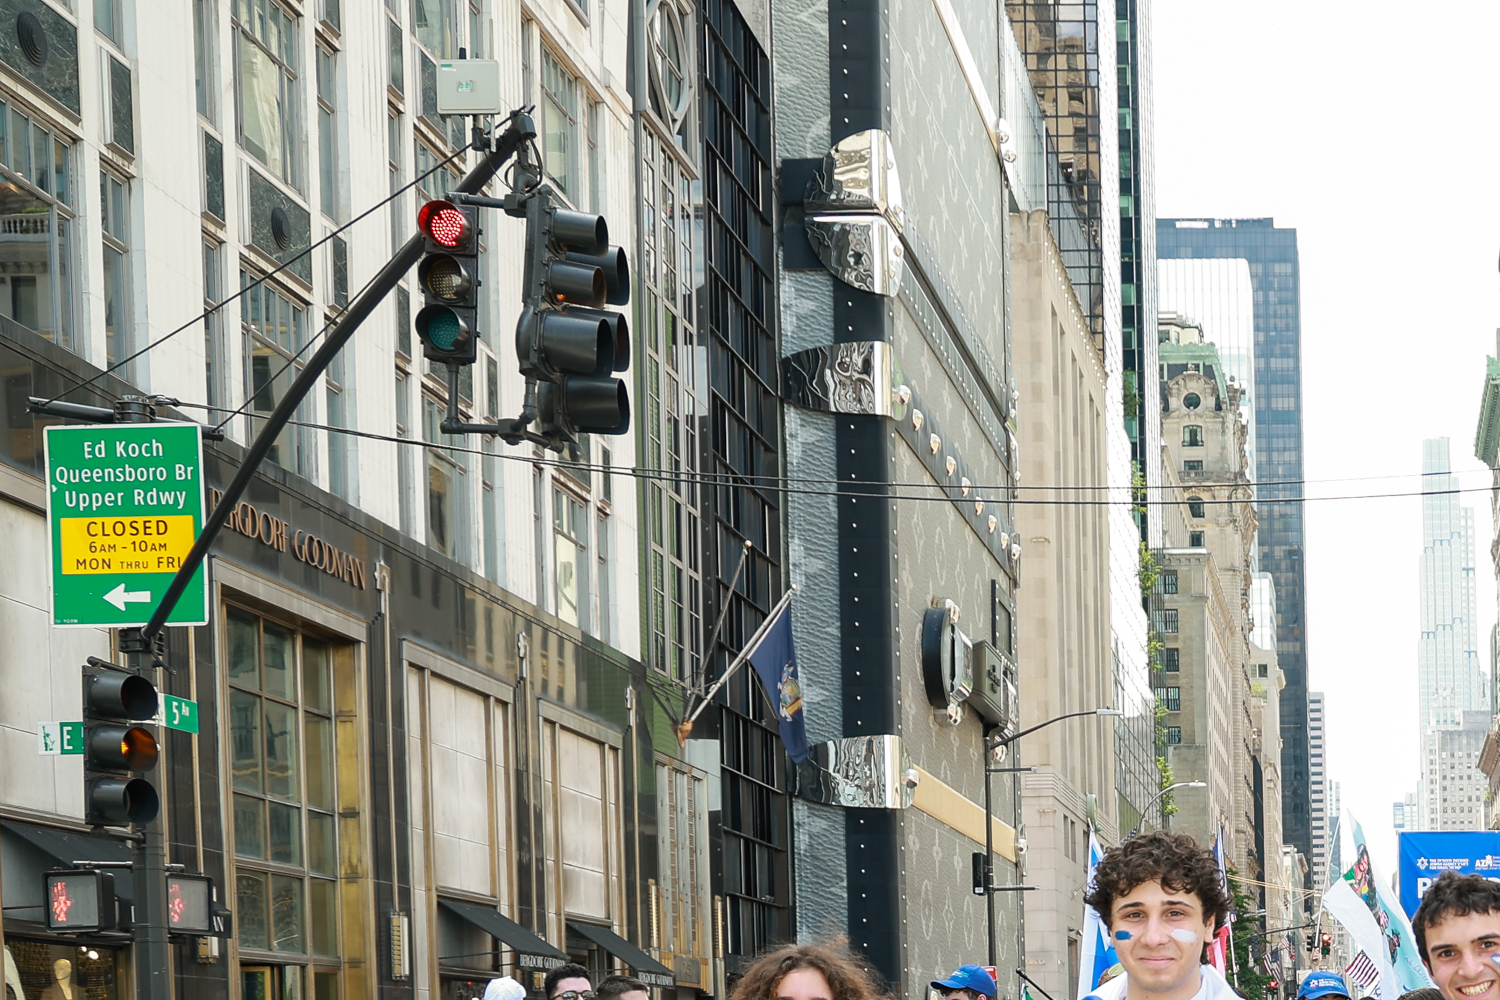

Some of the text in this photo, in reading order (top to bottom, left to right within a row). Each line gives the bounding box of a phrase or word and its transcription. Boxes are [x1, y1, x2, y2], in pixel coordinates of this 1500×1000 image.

[83, 439, 163, 458] Ed Koch
[55, 464, 194, 484] Queensboro Br
[64, 488, 186, 511] Upper Rdwy
[86, 520, 168, 537] CLOSED
[210, 488, 289, 552] BRGDORF
[76, 556, 181, 570] MON THRU FRI
[293, 529, 366, 590] GOODMAN
[172, 701, 180, 725] 5
[62, 726, 74, 750] E
